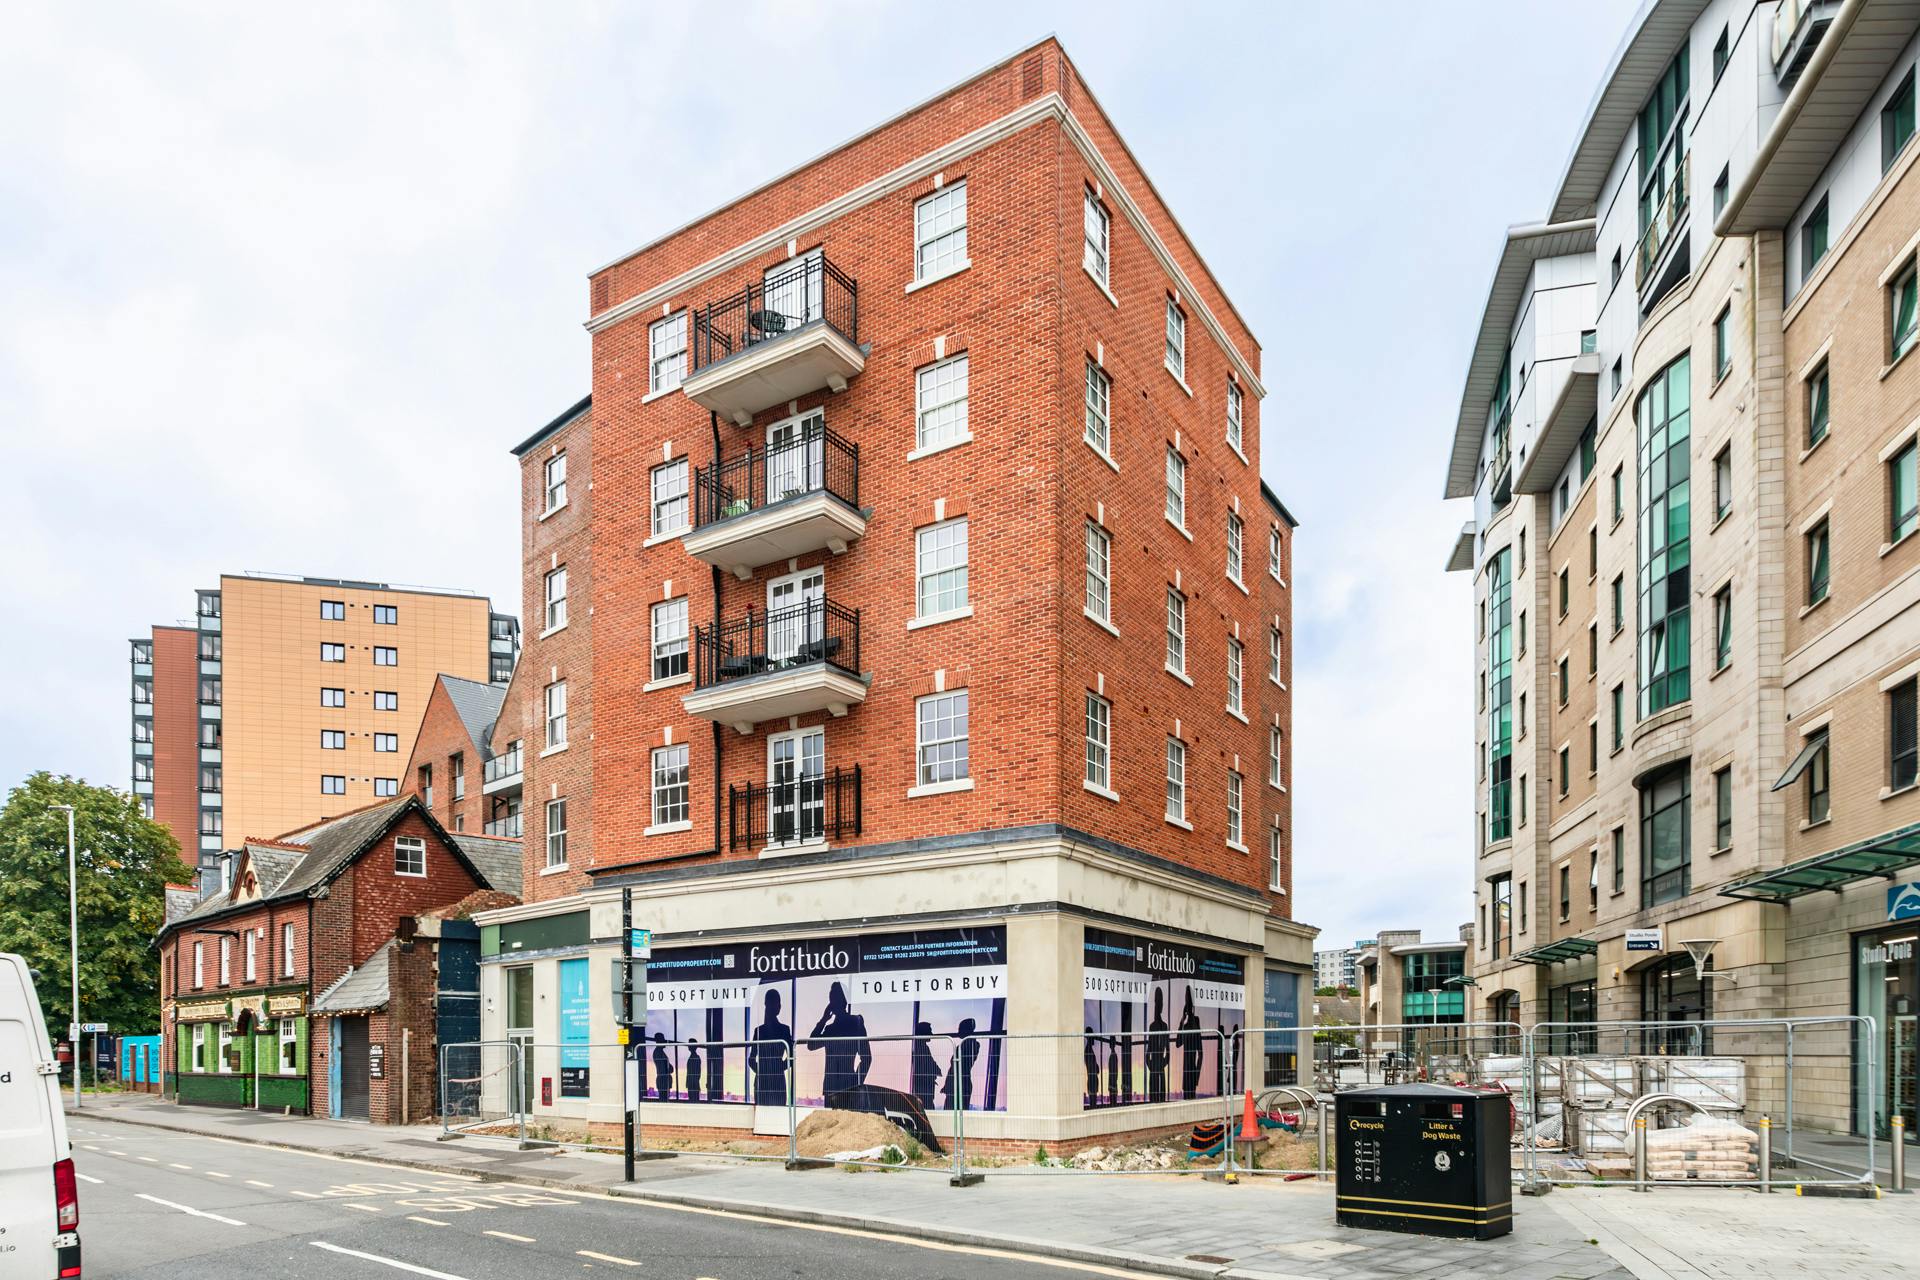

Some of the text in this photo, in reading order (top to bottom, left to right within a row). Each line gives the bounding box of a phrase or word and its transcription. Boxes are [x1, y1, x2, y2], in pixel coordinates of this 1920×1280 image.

[880, 940, 978, 952] CONTACT SALES FOR FURTHER INFORMATION
[1862, 942, 1912, 964] Studio Poole
[647, 957, 722, 969] WW.FORTITUDOPROPERTY.COM
[749, 945, 849, 973] fortitudo
[1147, 943, 1195, 975] fortitudo
[862, 975, 999, 994] TO LET OR BUY
[1085, 977, 1102, 991] 500
[1128, 981, 1147, 995] UNIT
[712, 987, 748, 1000] UNIT
[1195, 987, 1243, 1003] TO LET OR BUY
[1360, 1122, 1384, 1130] recycle
[1428, 1122, 1448, 1130] Litter
[1422, 1131, 1461, 1140] Dog Waste
[395, 1193, 581, 1212] BUS
